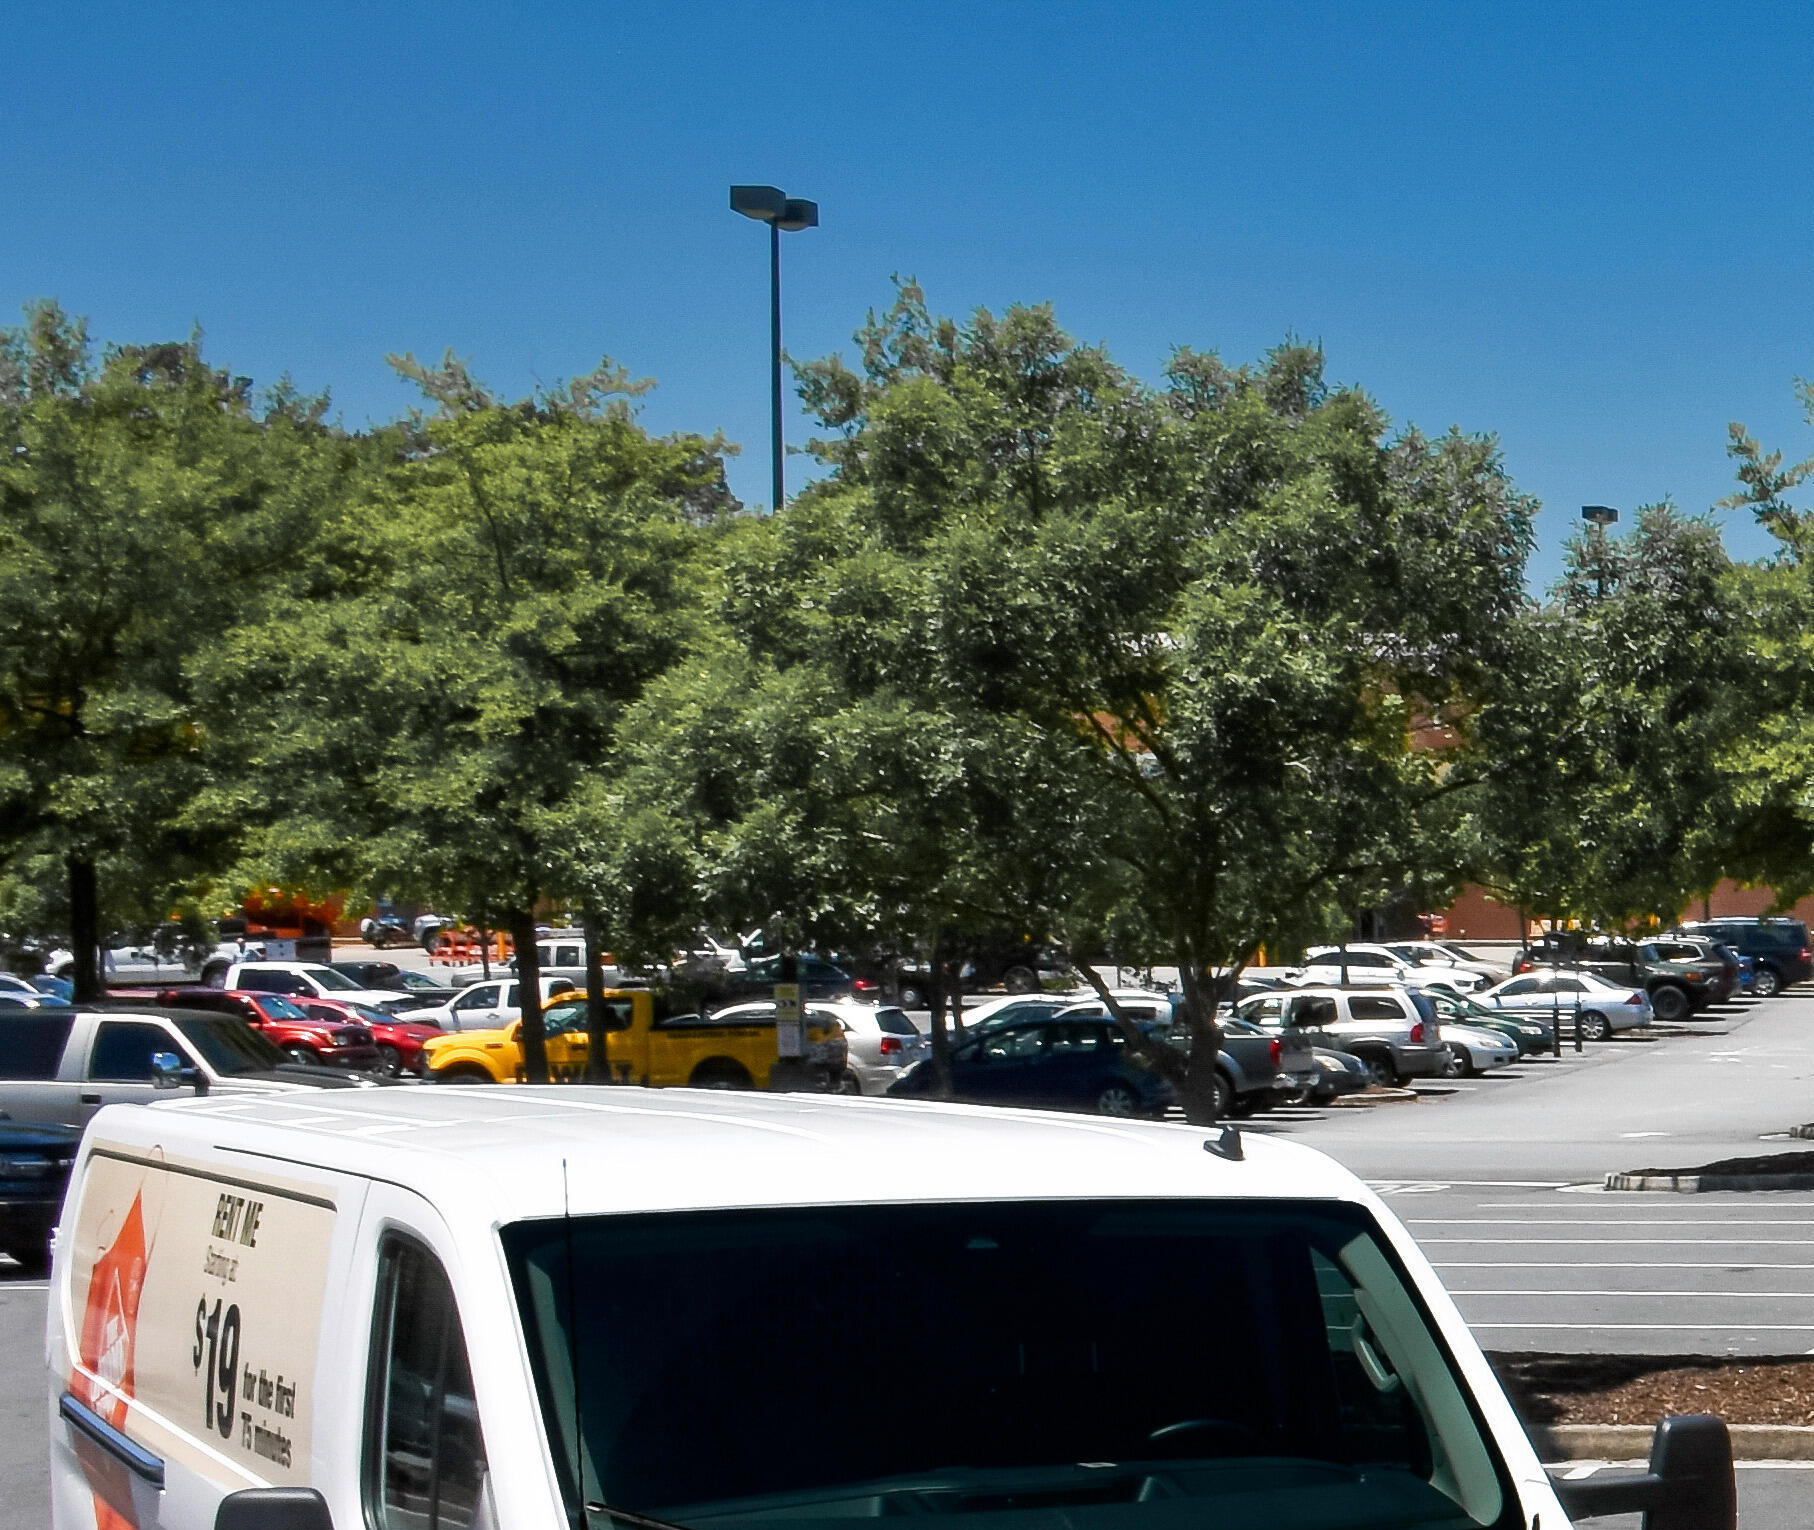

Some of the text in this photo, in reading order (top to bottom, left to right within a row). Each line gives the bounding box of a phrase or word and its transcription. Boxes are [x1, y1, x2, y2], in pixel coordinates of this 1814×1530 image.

[212, 1193, 264, 1248] RENT ME
[193, 1292, 241, 1439] $19
